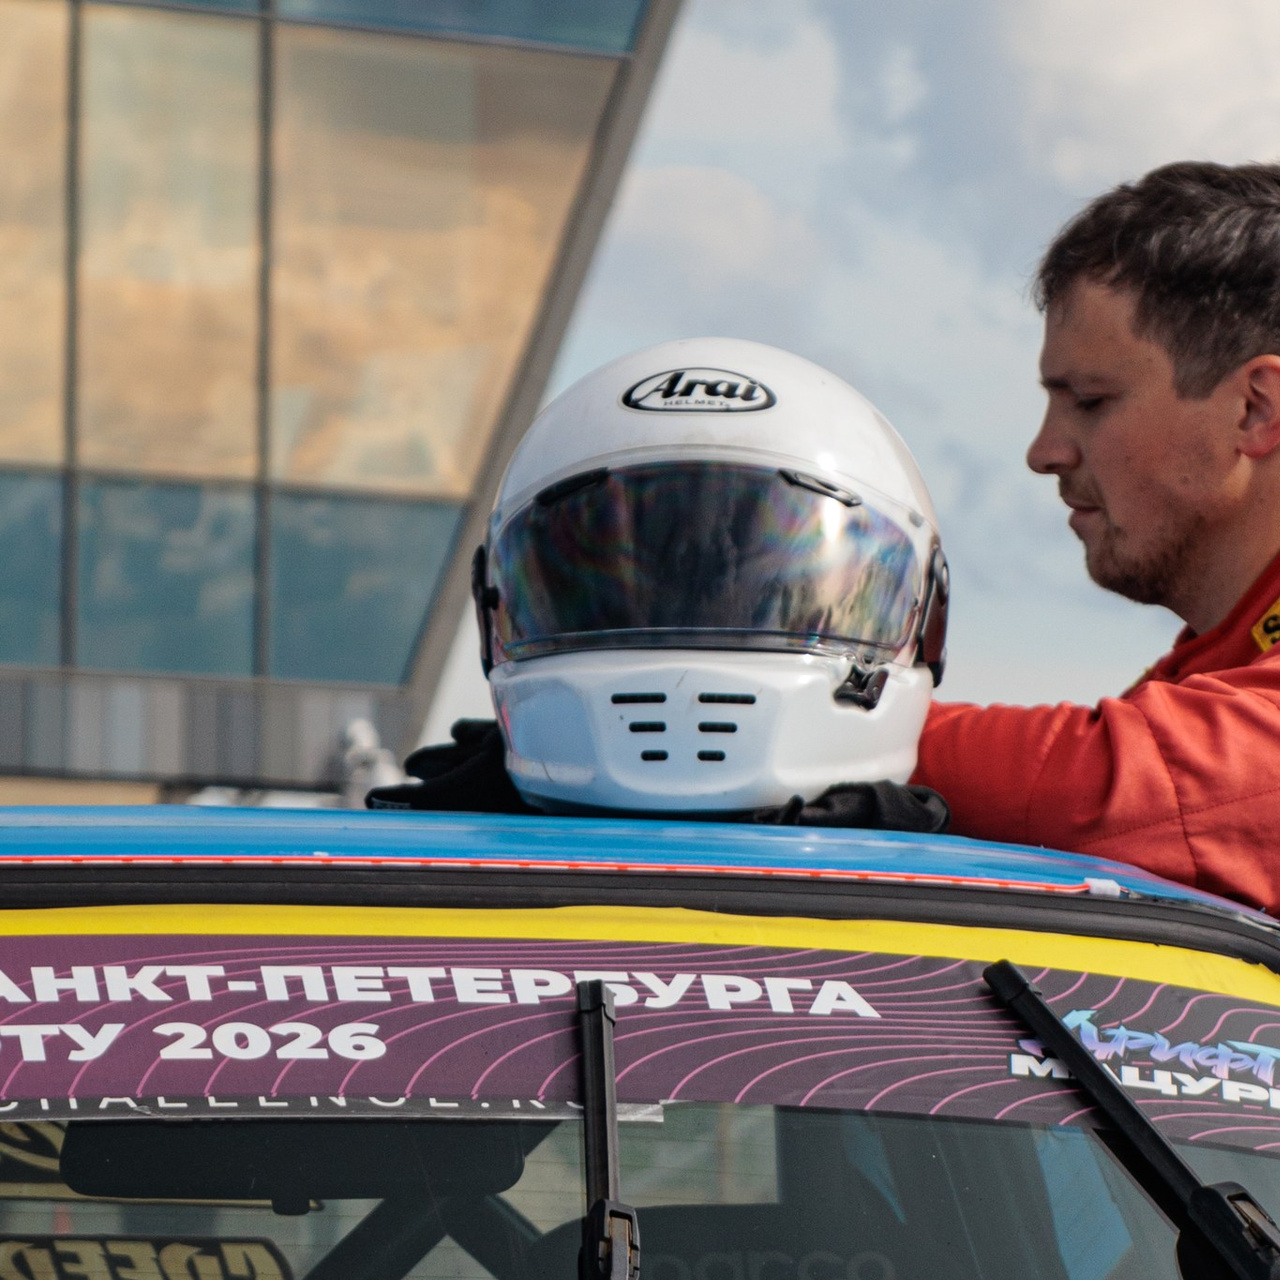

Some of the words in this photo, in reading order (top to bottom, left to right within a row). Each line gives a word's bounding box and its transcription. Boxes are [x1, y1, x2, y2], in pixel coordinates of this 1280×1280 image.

[637, 371, 761, 401] Arai
[0, 1022, 126, 1062] ТУ
[152, 1022, 388, 1061] 2026
